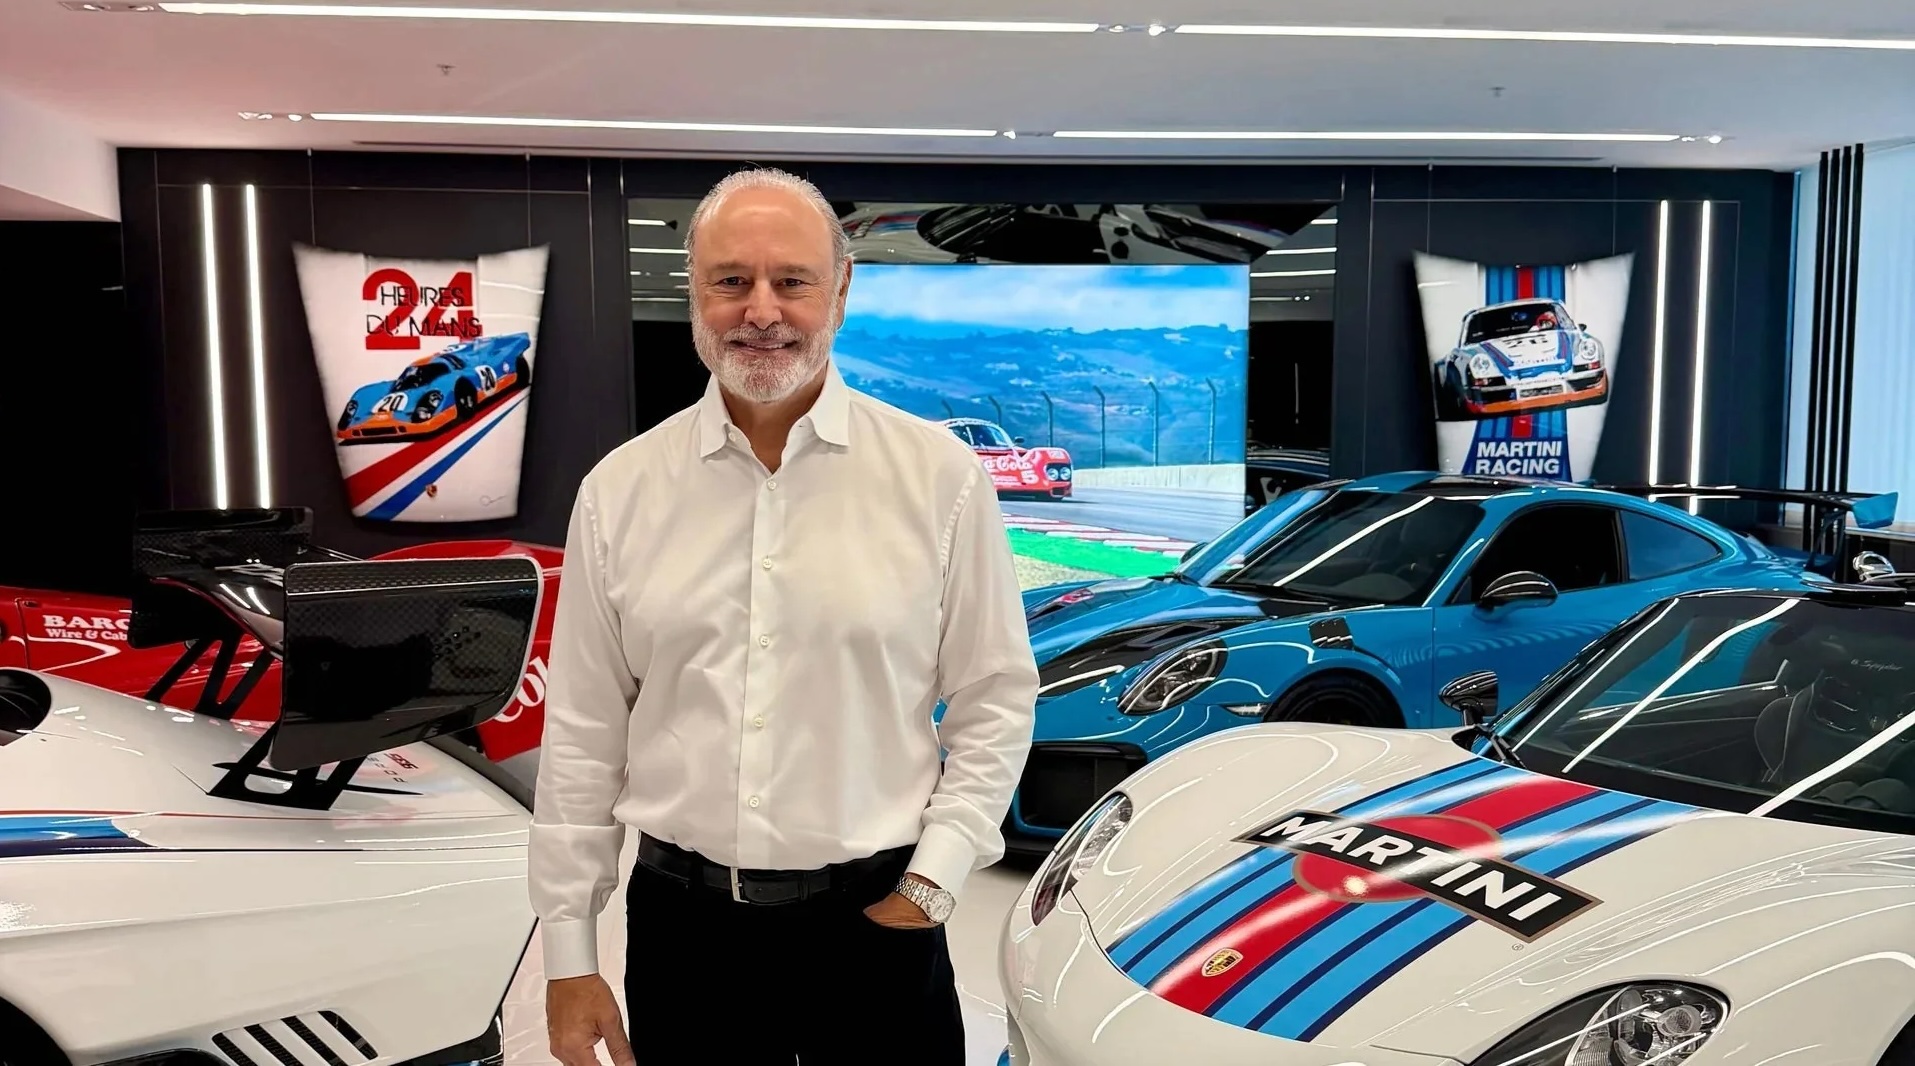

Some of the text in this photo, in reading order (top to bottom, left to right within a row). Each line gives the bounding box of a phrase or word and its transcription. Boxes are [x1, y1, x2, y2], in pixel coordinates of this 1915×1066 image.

[380, 285, 464, 306] HEURES
[363, 268, 482, 350] 24
[366, 314, 481, 338] DU MANS
[480, 367, 495, 393] 20
[378, 395, 404, 412] 20
[1476, 441, 1562, 457] MARTINI
[1475, 458, 1560, 475] RACING
[1021, 470, 1039, 484] 5
[45, 628, 82, 639] Wire
[84, 630, 98, 639] &
[1260, 816, 1562, 921] MARTINI
